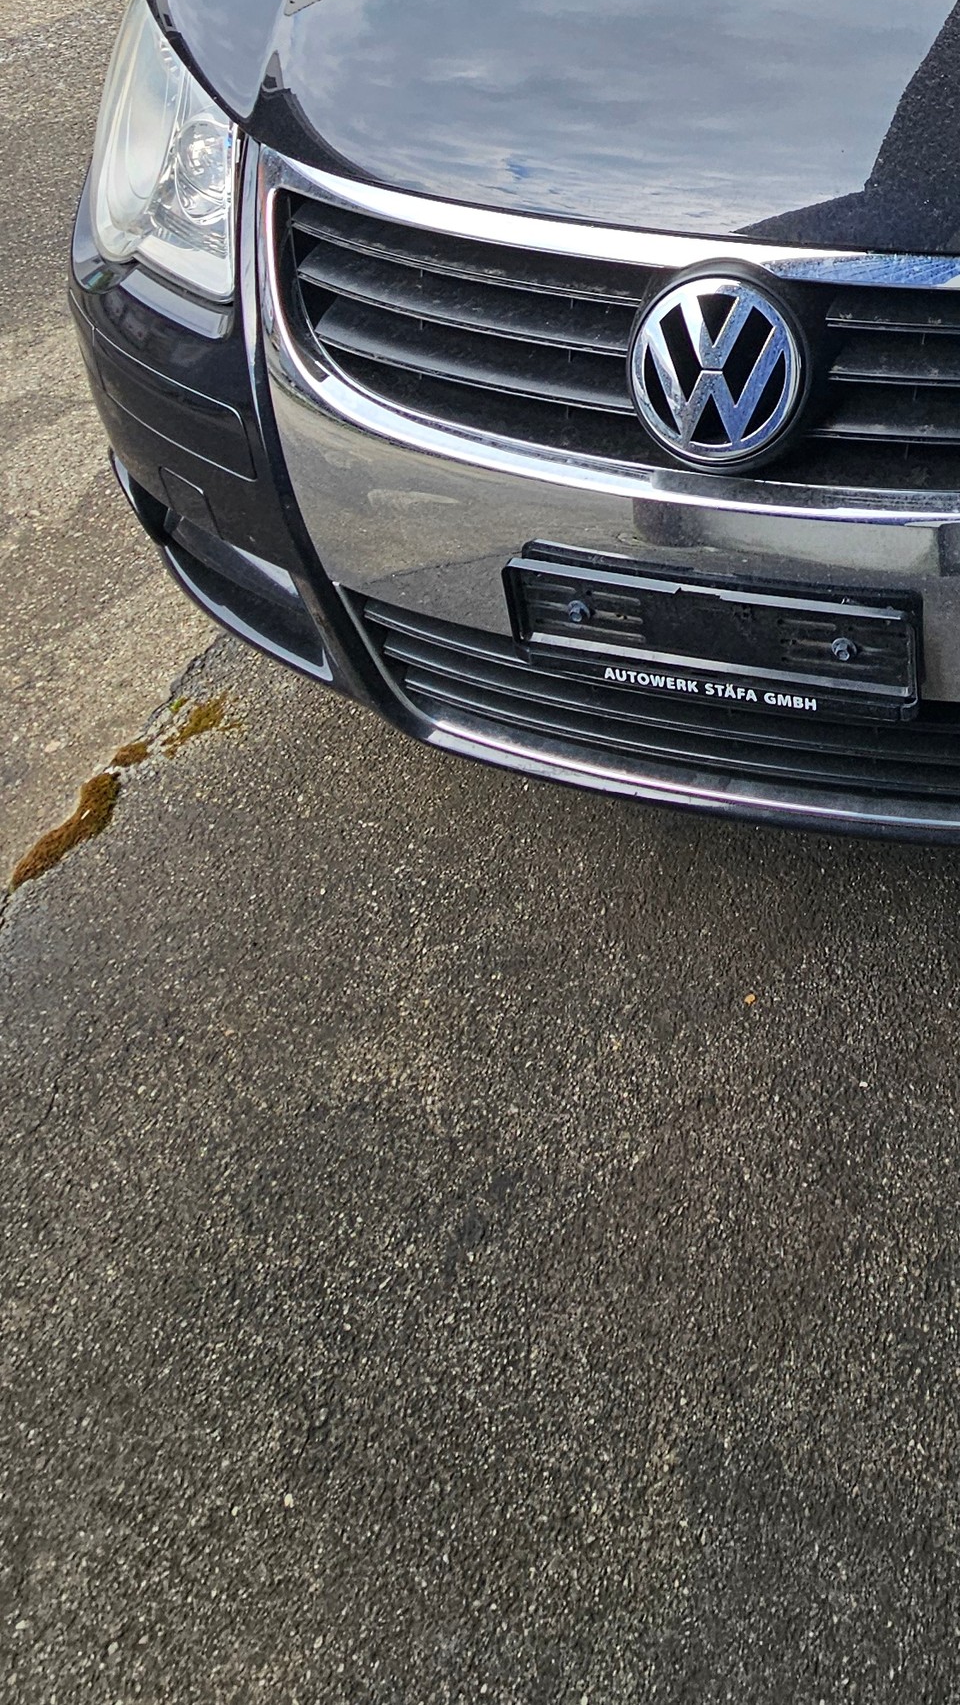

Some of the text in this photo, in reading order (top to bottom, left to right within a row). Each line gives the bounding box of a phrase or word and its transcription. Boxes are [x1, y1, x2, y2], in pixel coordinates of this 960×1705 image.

[633, 278, 800, 459] VW
[604, 667, 818, 712] AUTOWERK STÄFA GMBH
